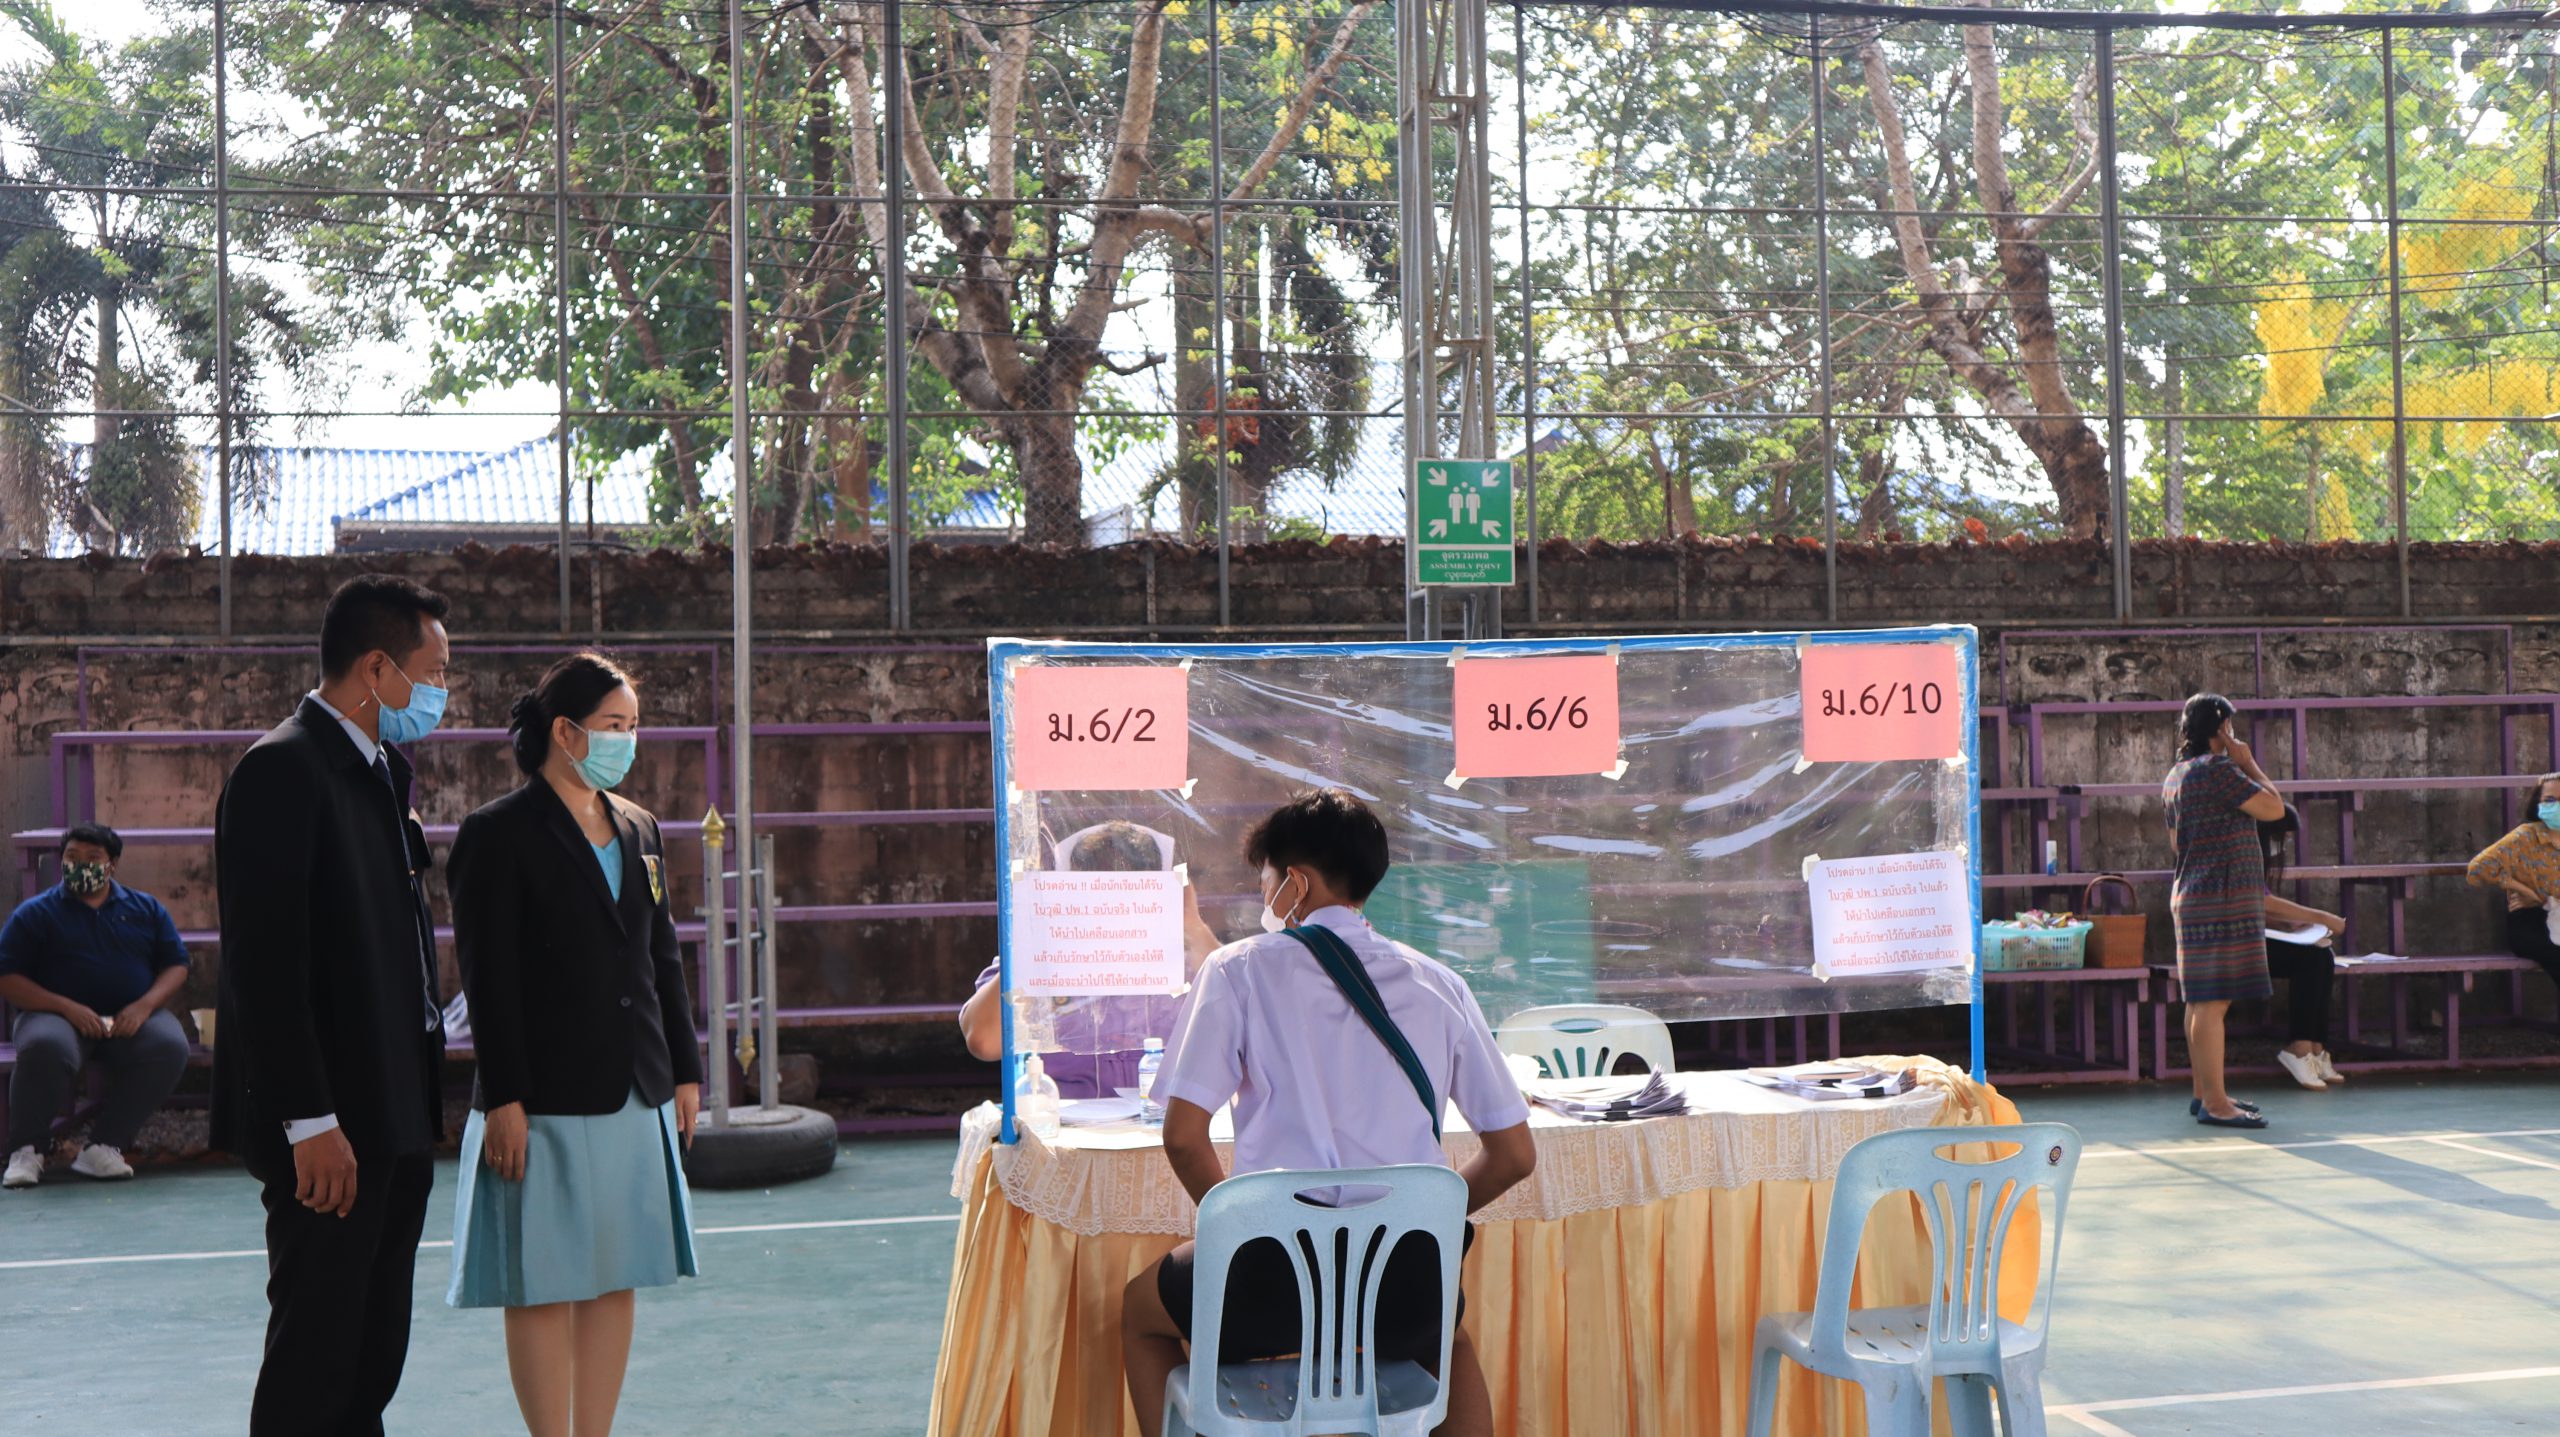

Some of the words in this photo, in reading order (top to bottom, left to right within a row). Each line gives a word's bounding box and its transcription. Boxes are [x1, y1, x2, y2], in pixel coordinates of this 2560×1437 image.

[1488, 696, 1588, 731] ม.6/6
[1822, 682, 1942, 716] ม.6/10
[1048, 707, 1156, 744] ม.6/2
[1033, 878, 1077, 891] โปรดอ่าน
